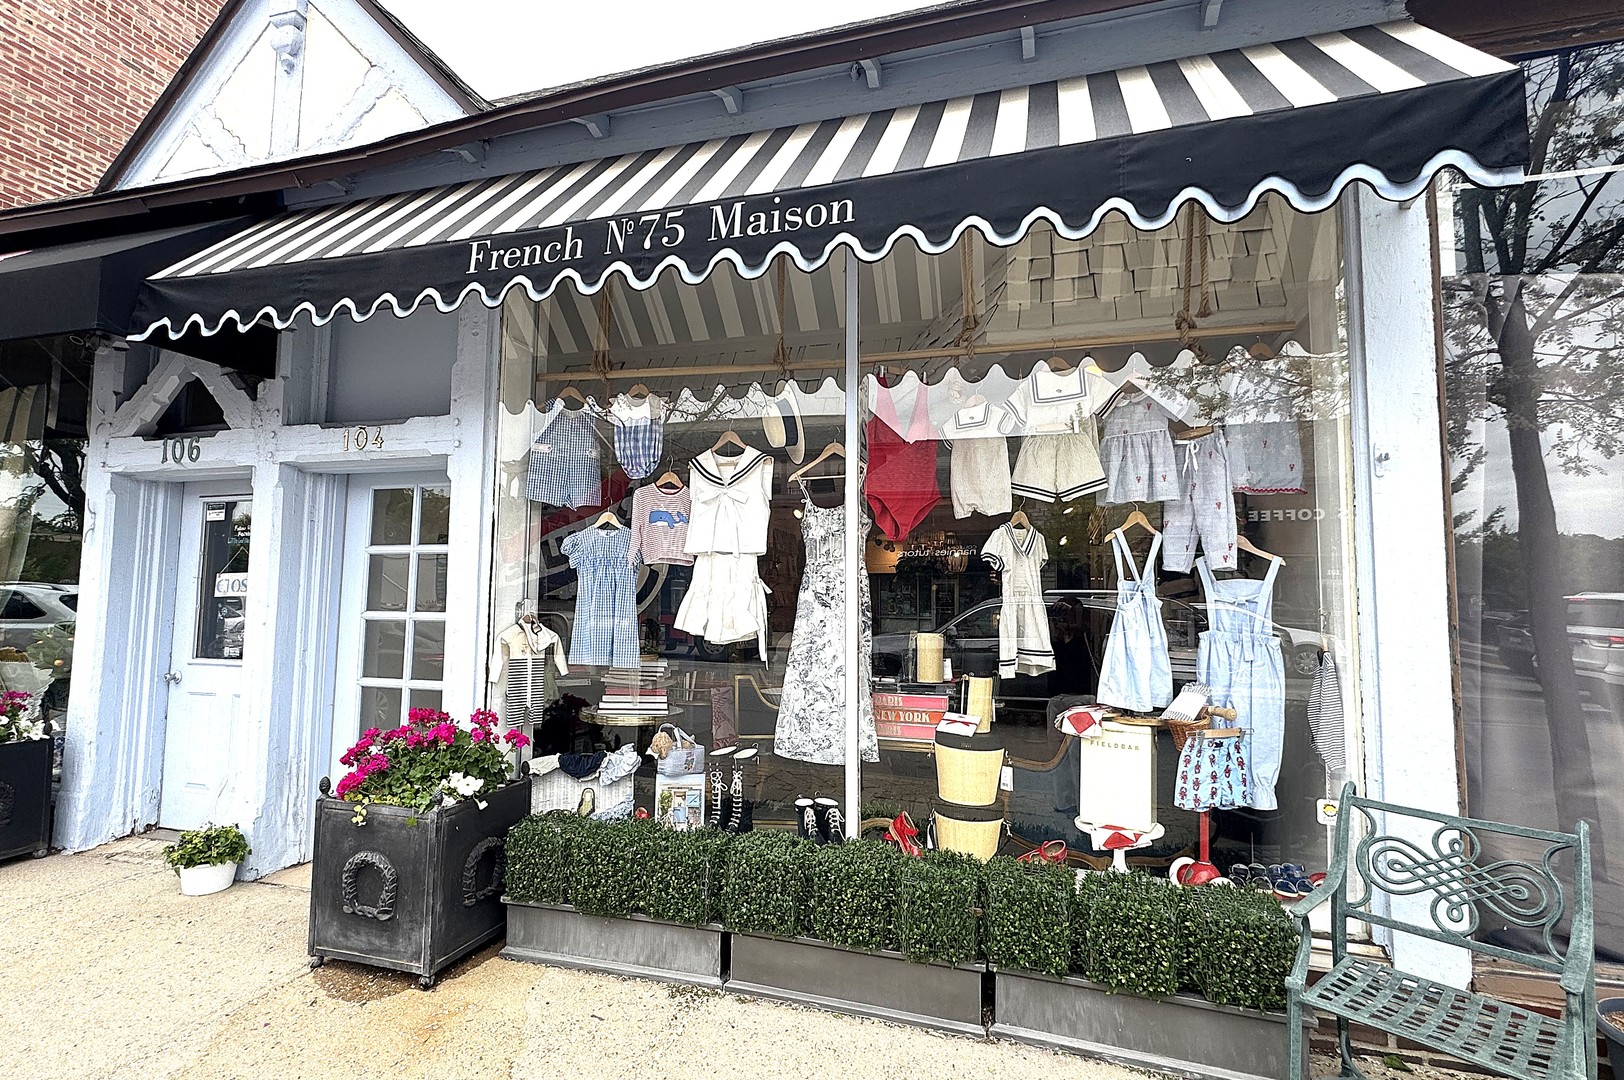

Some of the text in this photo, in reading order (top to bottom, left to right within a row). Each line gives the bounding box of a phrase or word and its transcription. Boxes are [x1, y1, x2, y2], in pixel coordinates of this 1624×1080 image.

[465, 227, 584, 274] French
[707, 196, 856, 242] Maison
[161, 435, 201, 464] 106
[343, 427, 384, 452] 104
[898, 710, 931, 723] YORK
[1090, 740, 1140, 751] FIELDBAR
